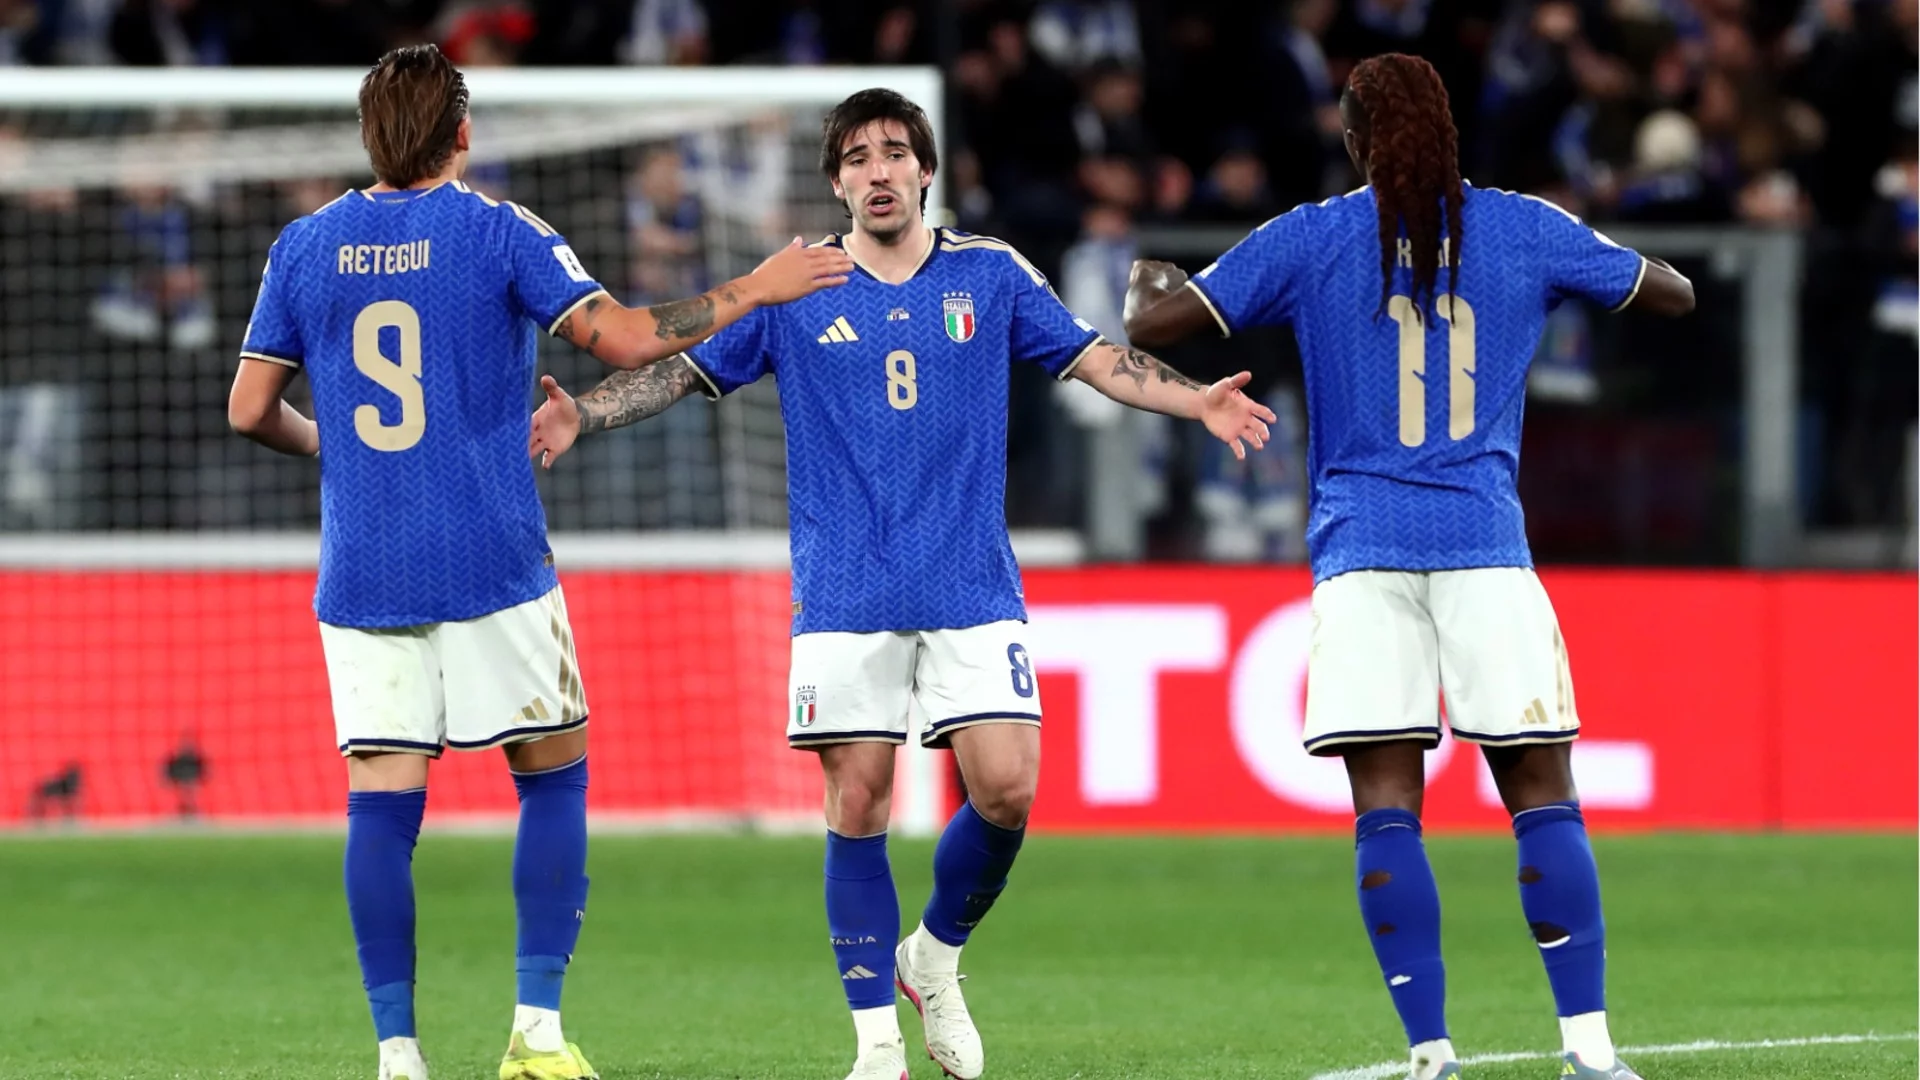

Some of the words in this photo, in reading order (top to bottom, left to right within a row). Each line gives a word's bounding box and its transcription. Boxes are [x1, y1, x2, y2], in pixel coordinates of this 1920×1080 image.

[338, 239, 430, 275] RETEGUI
[353, 300, 426, 452] 9
[885, 349, 918, 411] 8
[1388, 293, 1476, 447] 11
[1007, 642, 1034, 699] 8
